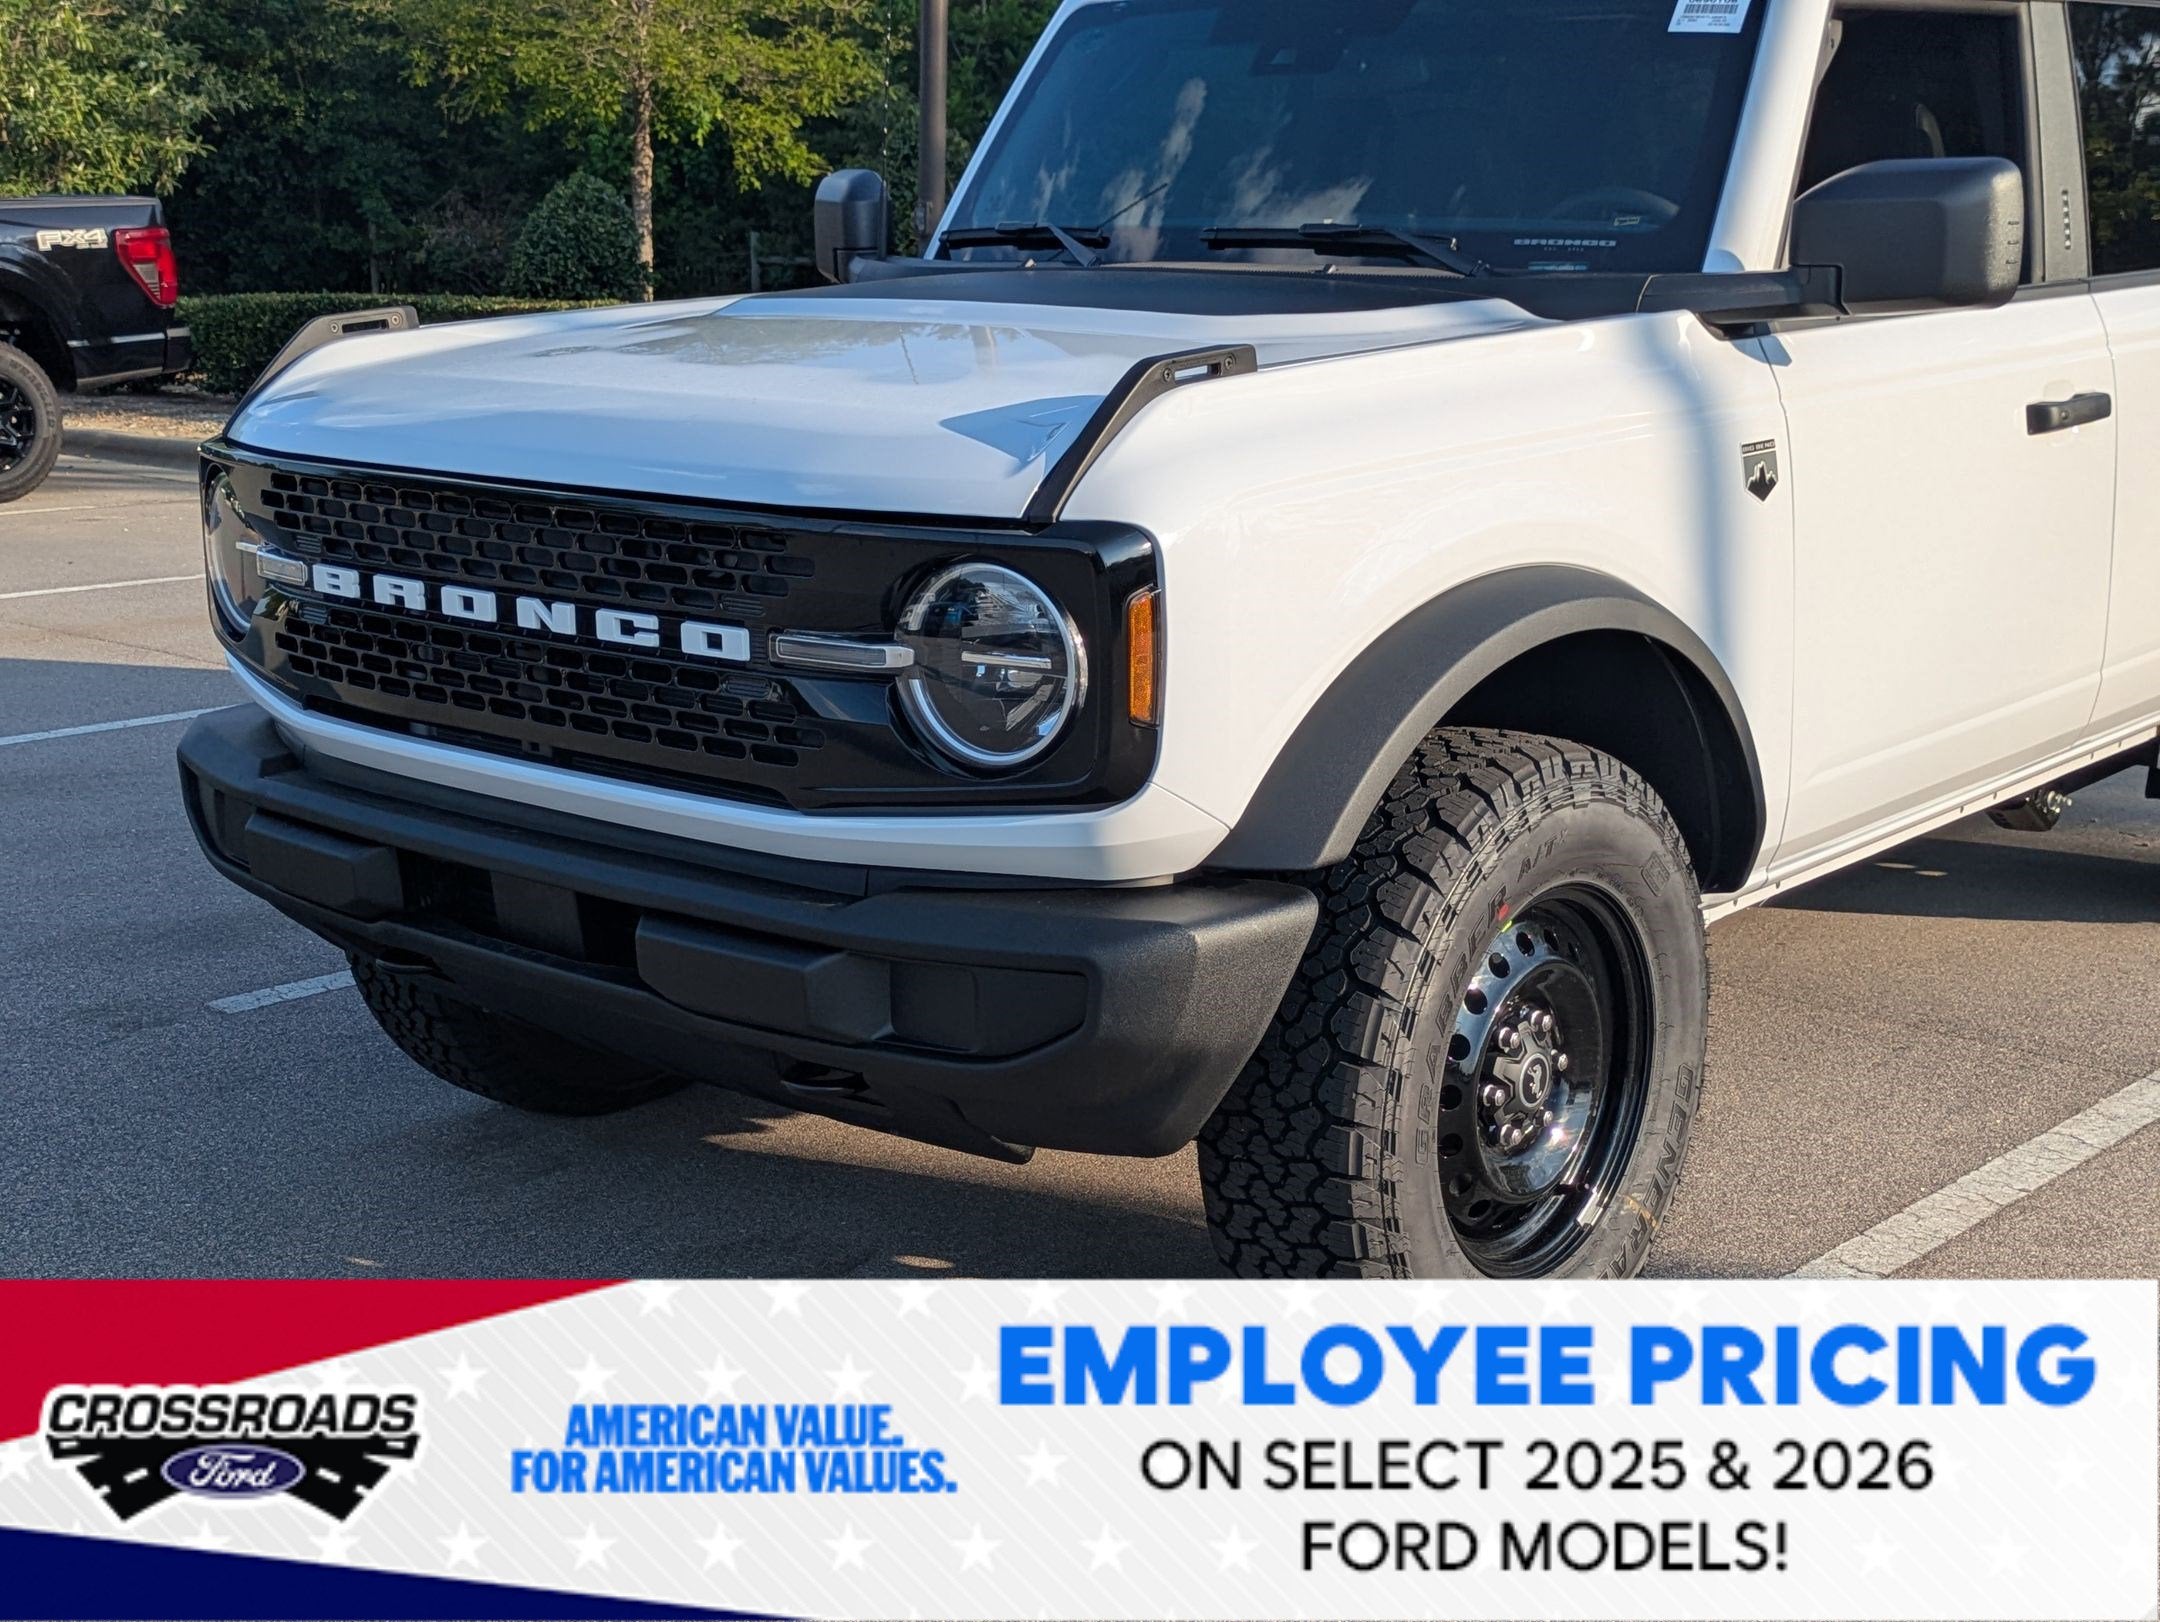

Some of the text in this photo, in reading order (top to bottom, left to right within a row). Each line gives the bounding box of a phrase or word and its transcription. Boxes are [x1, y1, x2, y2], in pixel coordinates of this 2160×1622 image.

[36, 228, 108, 251] FX4
[1513, 239, 1617, 247] BRONCO
[312, 563, 751, 662] BRONCO
[1596, 1062, 1695, 1279] GENERA
